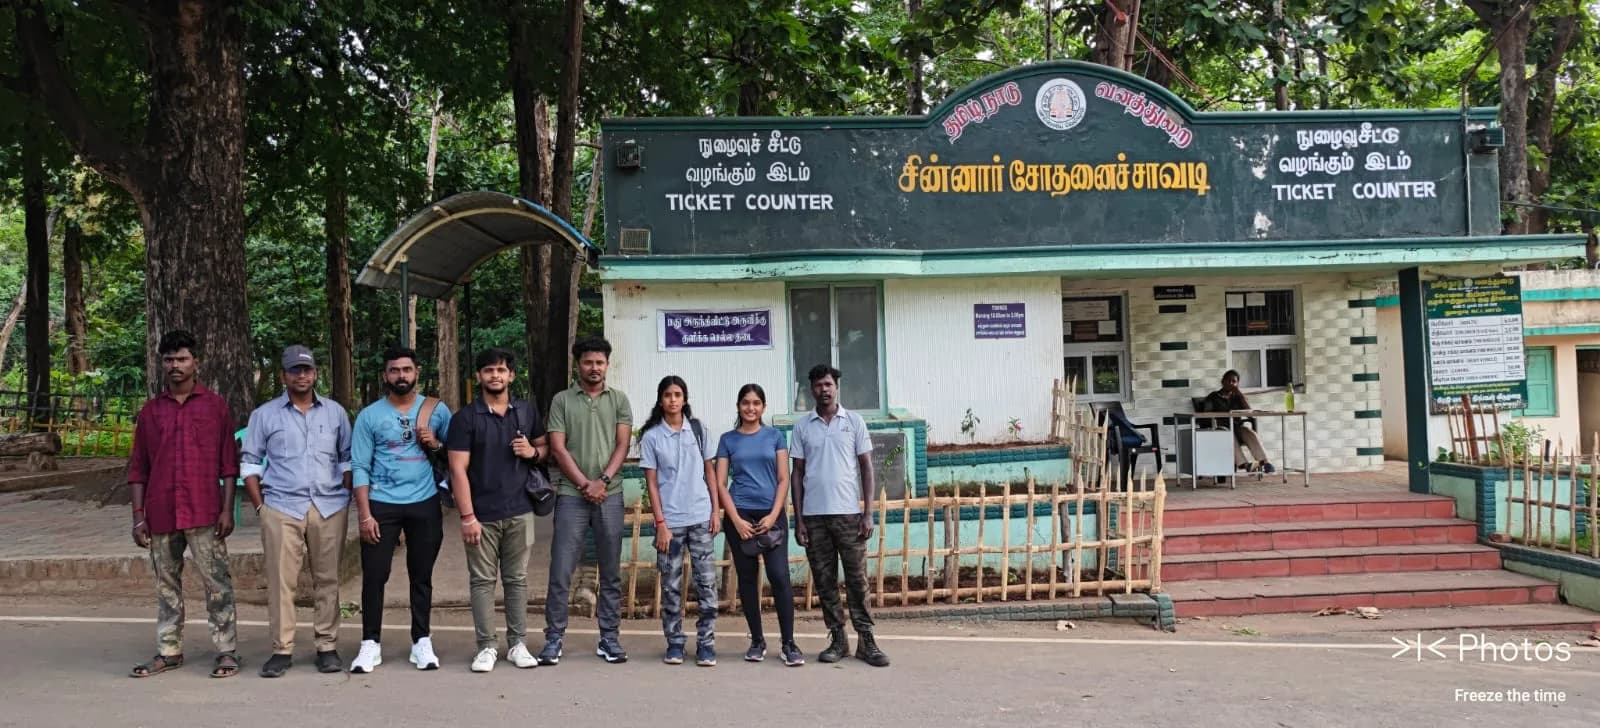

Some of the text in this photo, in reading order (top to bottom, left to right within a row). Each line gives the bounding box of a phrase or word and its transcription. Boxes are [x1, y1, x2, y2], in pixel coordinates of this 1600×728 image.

[981, 81, 1022, 119] நாடு
[1095, 82, 1193, 149] வனத்துறை
[698, 129, 802, 159] நுழைவுச் சீட்டு
[685, 161, 811, 188] வழங்கும் இடம்
[898, 152, 1212, 197] சின்னார் சோதனைச்சாவடி
[1278, 150, 1412, 177] வழங்கும் இடம்
[665, 193, 834, 211] TICKET COUNTER
[1271, 181, 1437, 201] TICKET COUNTER
